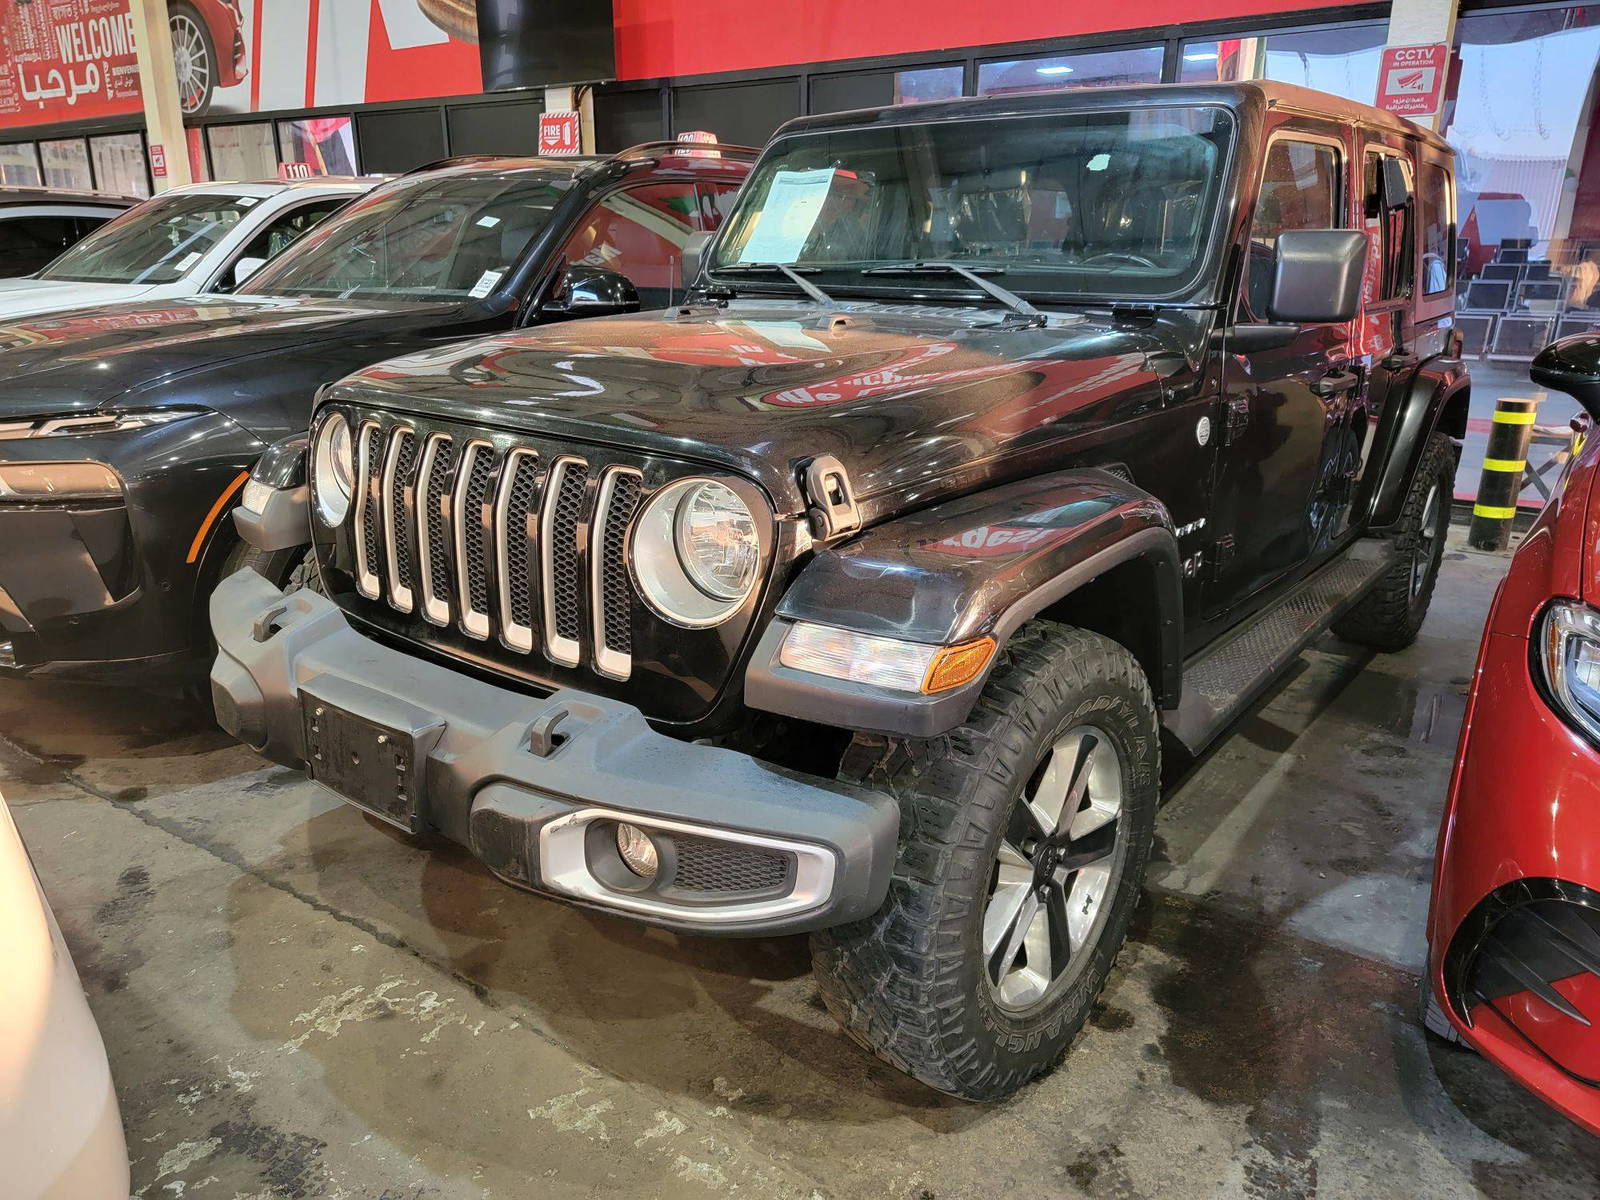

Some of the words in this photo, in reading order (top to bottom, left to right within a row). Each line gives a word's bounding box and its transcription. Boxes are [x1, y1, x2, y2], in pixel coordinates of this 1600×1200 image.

[55, 12, 137, 64] WELCOME
[1395, 48, 1435, 60] CCTV
[1400, 59, 1434, 67] OPERATION
[17, 62, 100, 109] مرحبا
[543, 125, 560, 136] FIRE
[286, 164, 309, 178] 110
